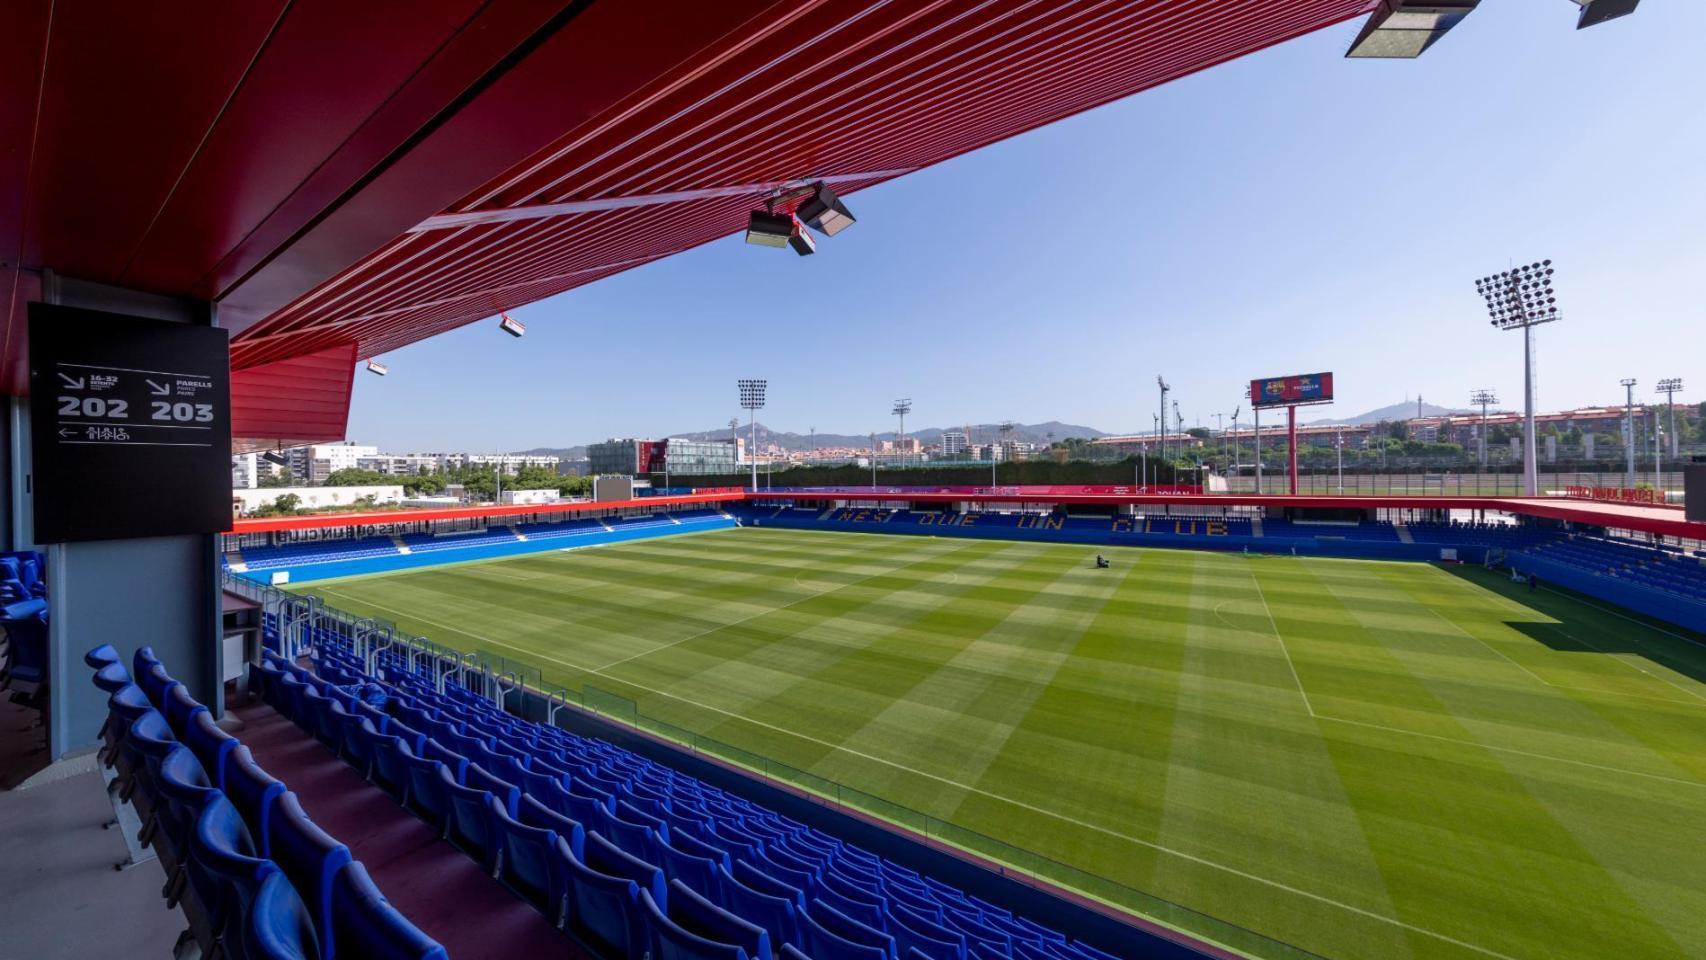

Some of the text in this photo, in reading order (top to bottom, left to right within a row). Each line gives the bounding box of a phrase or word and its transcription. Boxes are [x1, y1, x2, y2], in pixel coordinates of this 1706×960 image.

[176, 379, 213, 389] PARELLS
[57, 396, 129, 418] 202
[151, 401, 214, 422] 203
